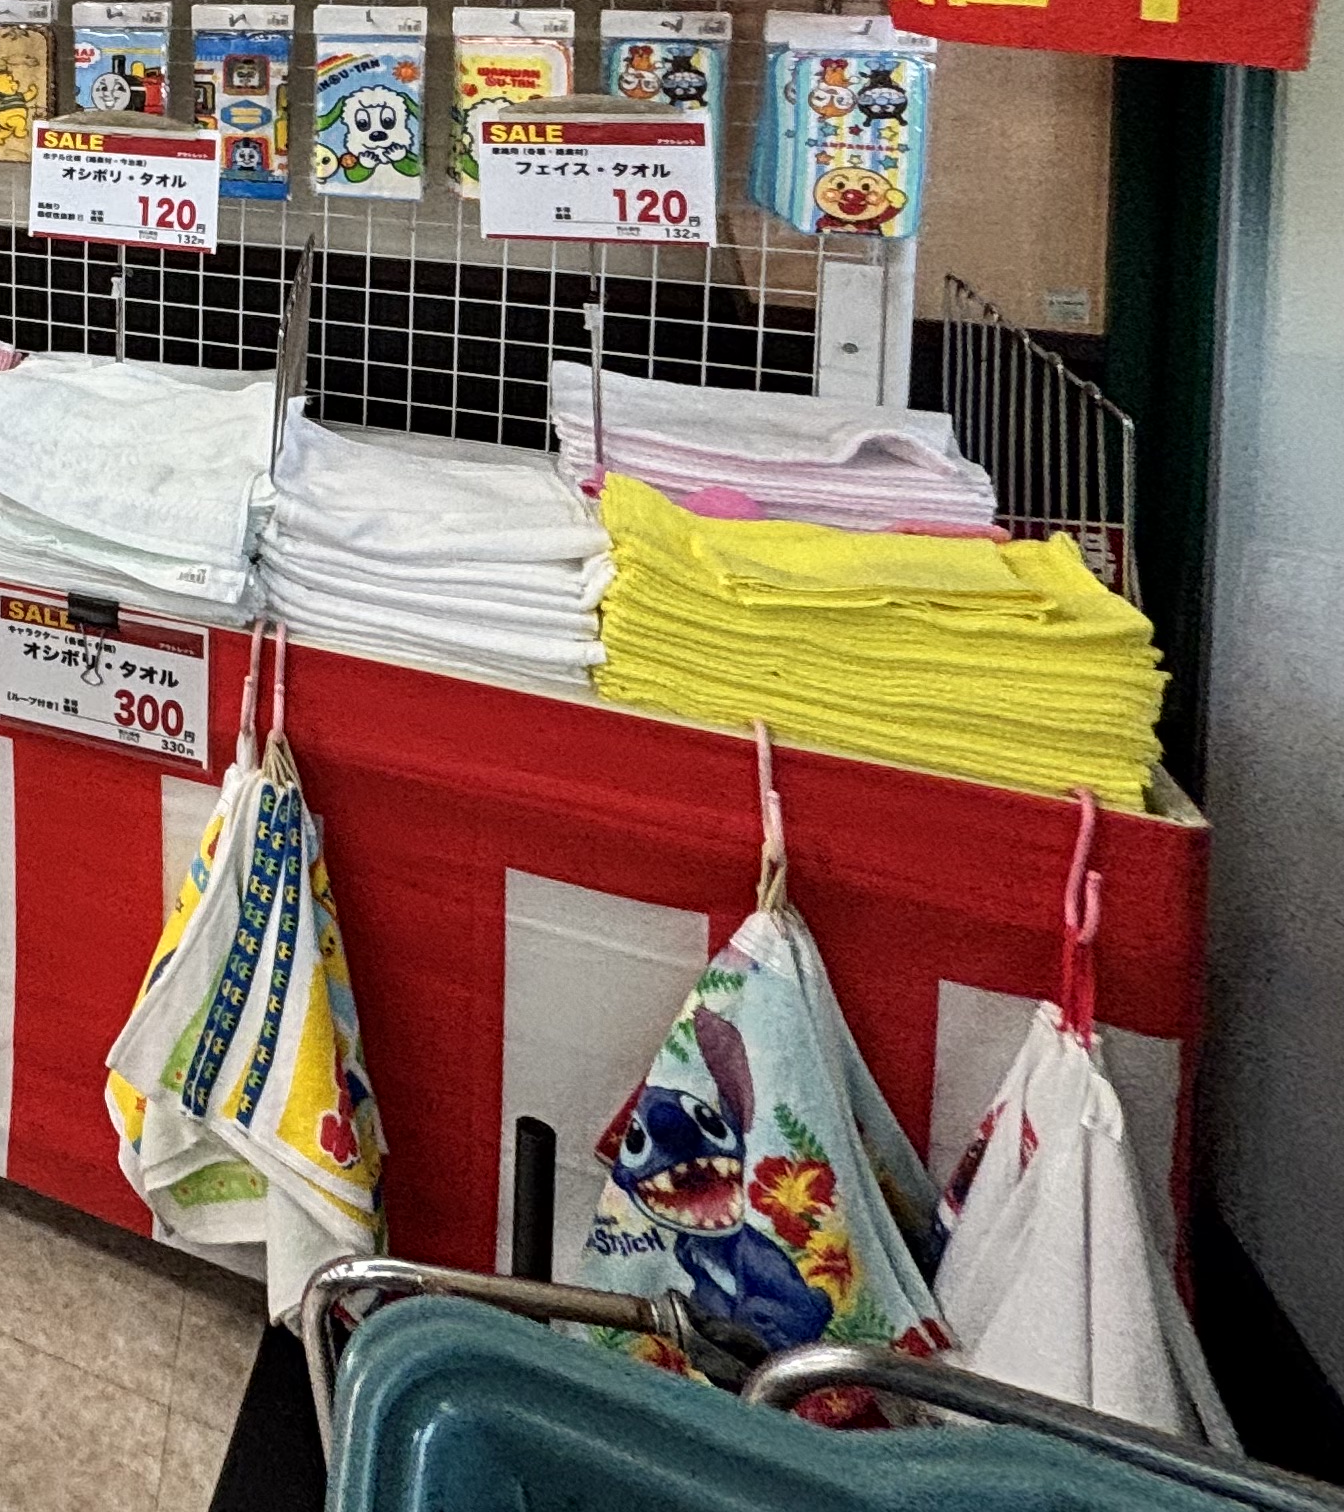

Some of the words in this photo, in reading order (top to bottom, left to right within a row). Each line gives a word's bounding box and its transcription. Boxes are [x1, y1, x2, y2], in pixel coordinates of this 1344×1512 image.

[43, 131, 105, 152] SALE
[489, 124, 564, 143] SALE
[515, 161, 671, 178] フェイス・タオル
[8, 600, 76, 630] SALE
